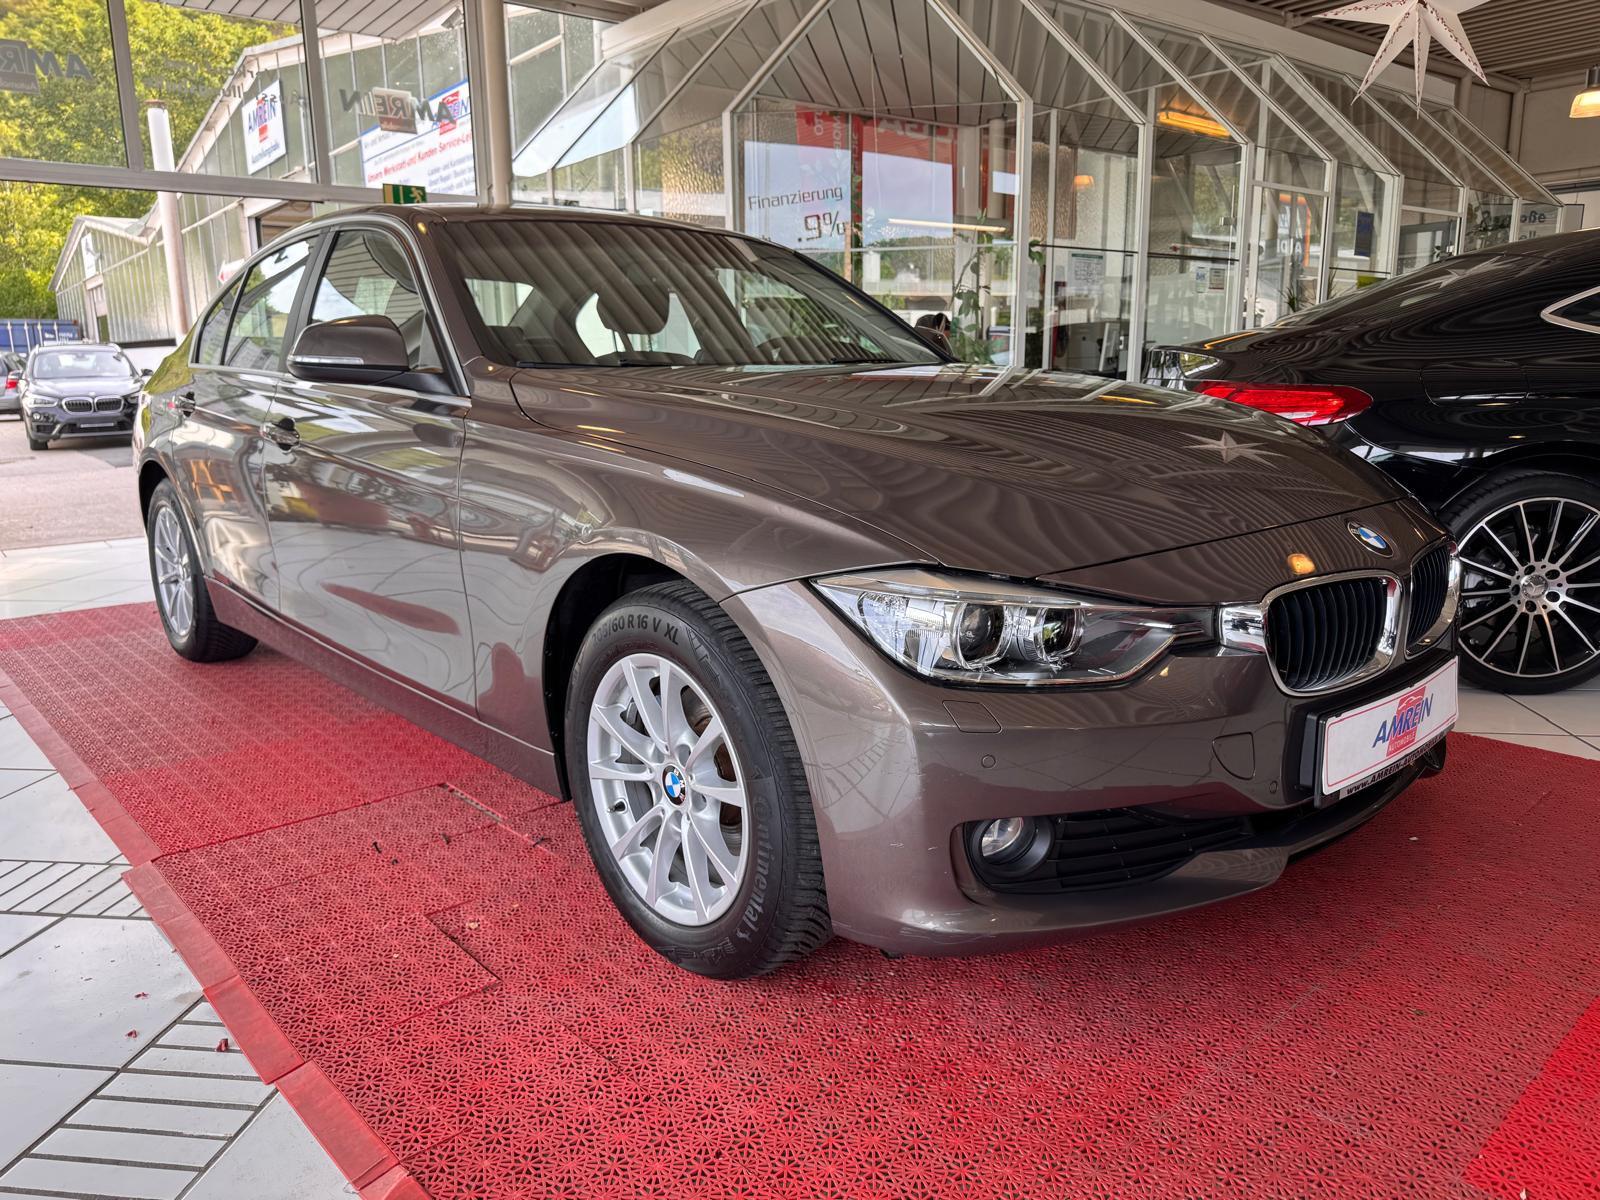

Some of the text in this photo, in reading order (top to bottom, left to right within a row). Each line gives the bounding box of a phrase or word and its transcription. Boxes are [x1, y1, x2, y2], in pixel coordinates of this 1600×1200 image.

[748, 187, 843, 210] Finanzierung
[652, 617, 662, 632] V
[663, 622, 680, 646] XL
[1372, 693, 1434, 749] AMREIN
[743, 796, 775, 932] Continental
